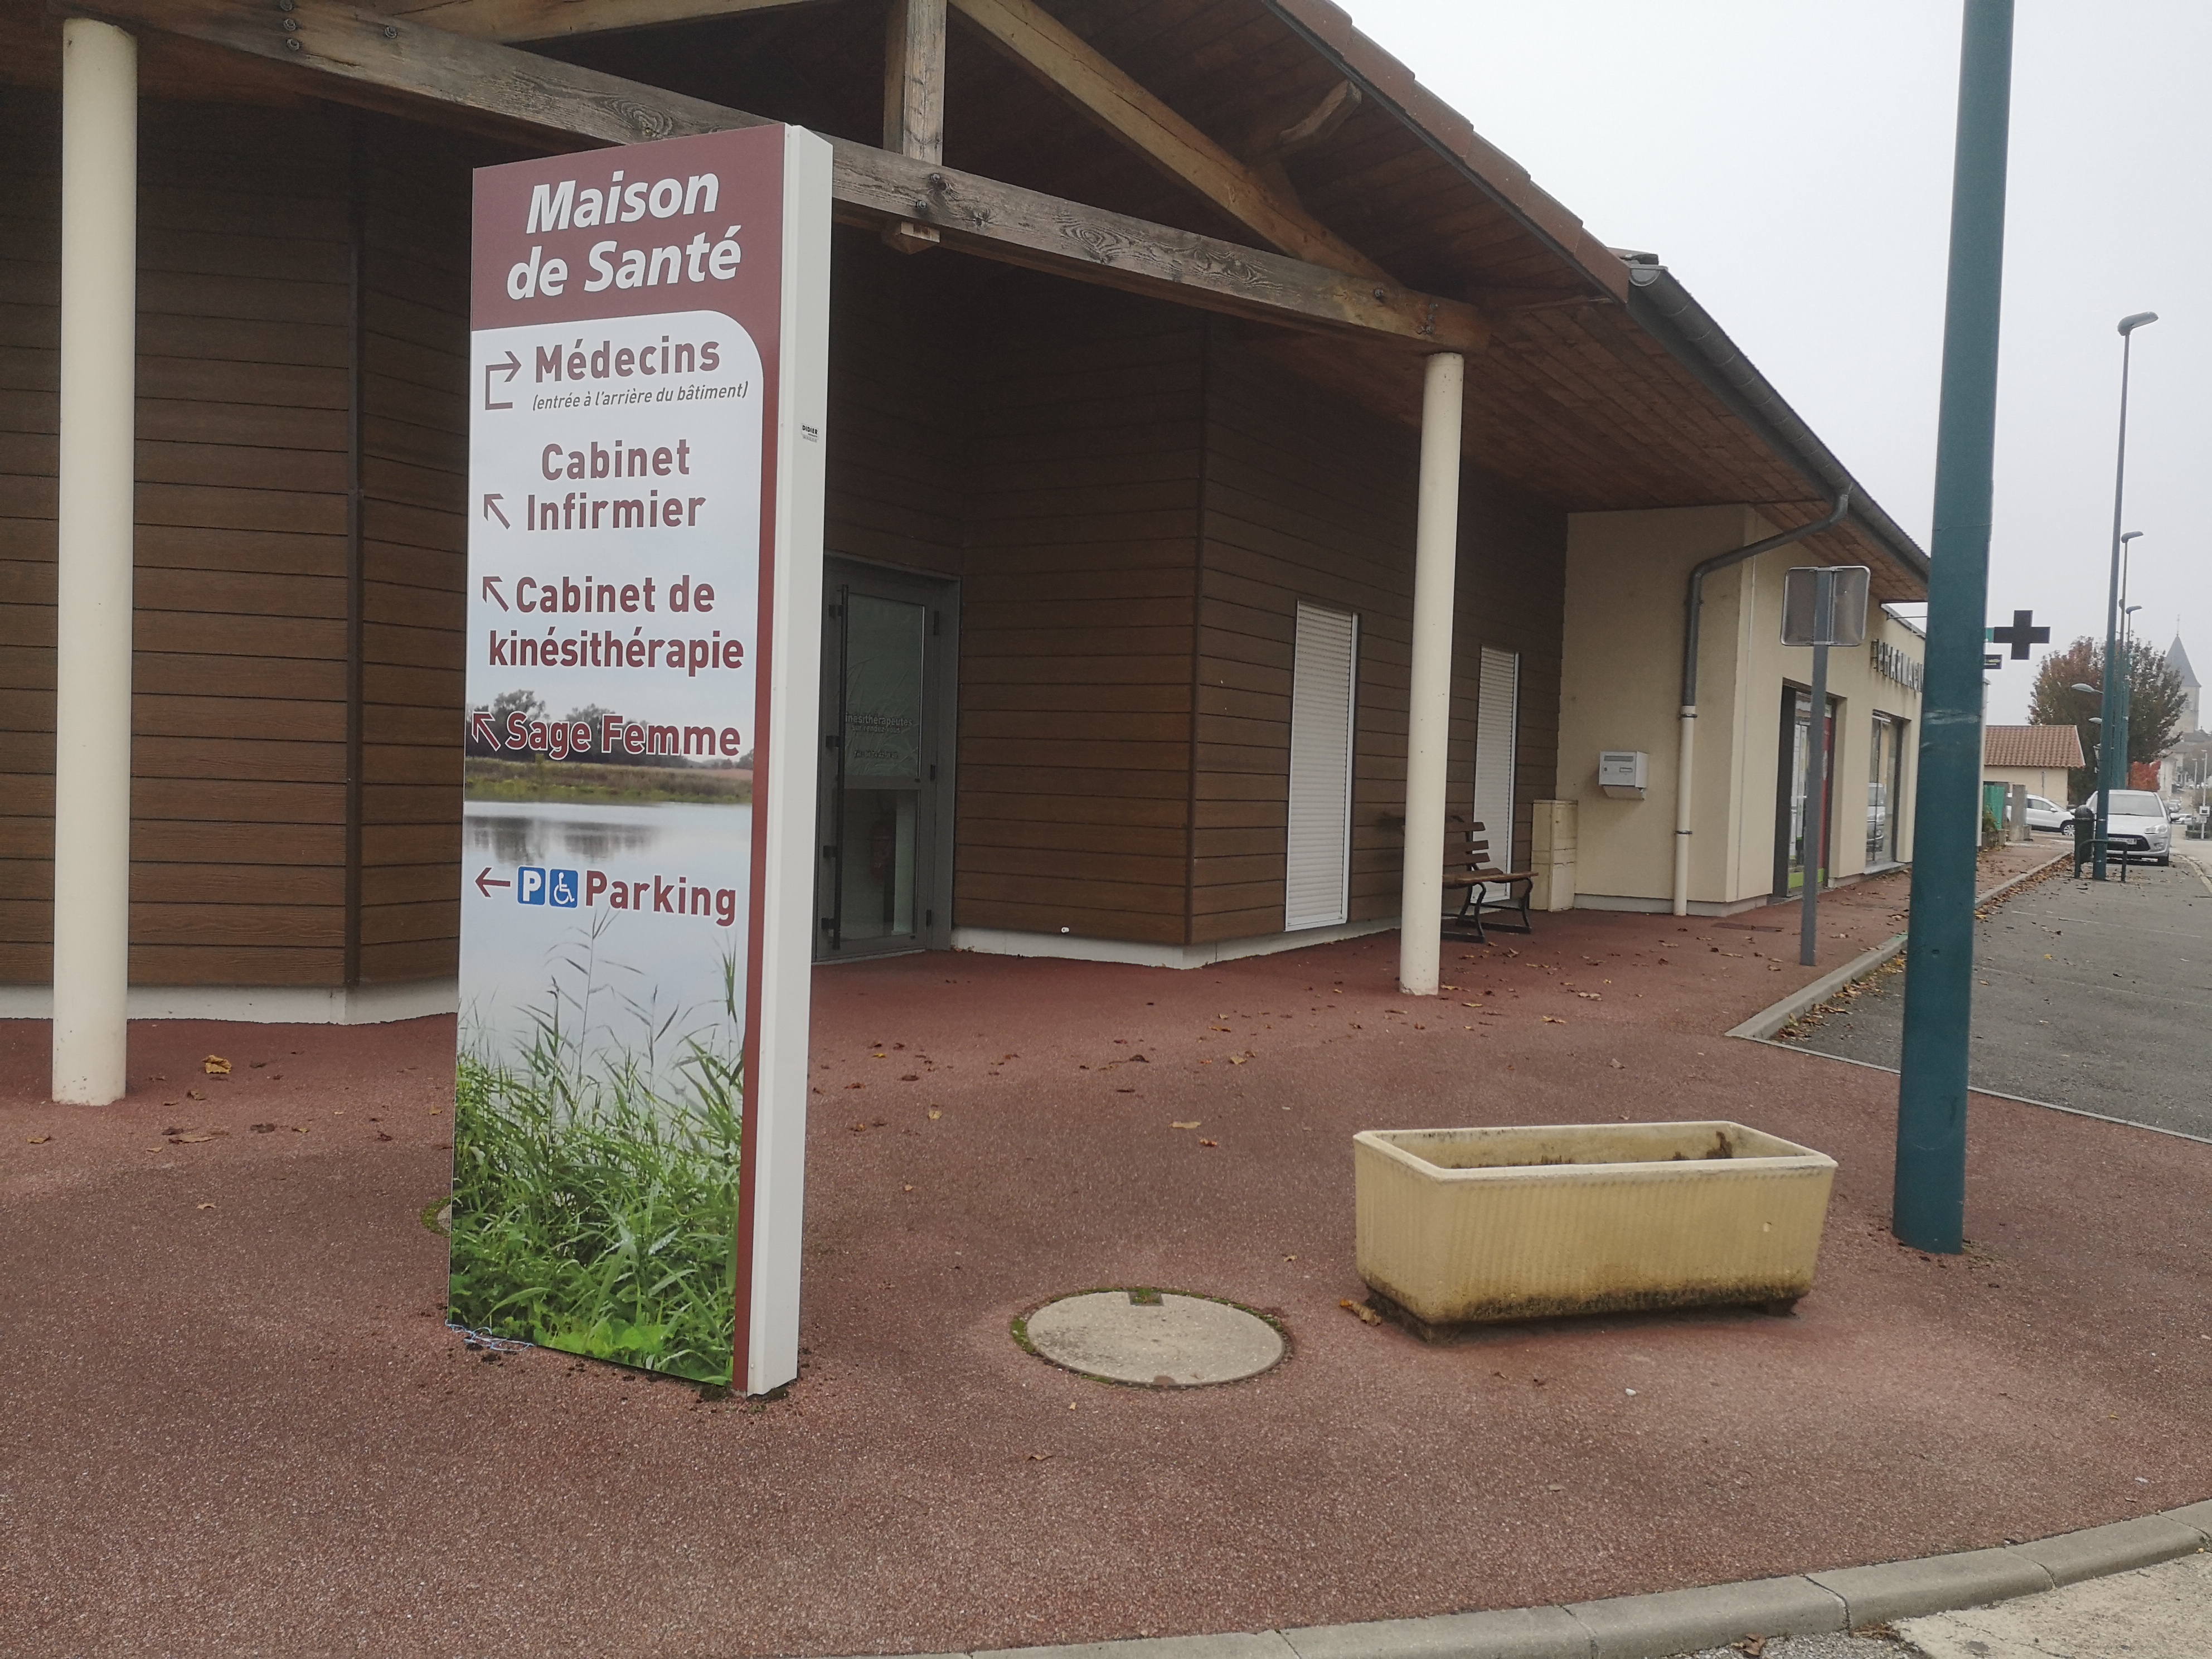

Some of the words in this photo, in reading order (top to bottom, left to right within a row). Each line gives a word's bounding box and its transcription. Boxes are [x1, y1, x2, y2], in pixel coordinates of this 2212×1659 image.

[525, 170, 719, 234] Maison
[506, 245, 567, 300] de
[584, 225, 741, 292] Santé
[535, 335, 720, 383] Médecins
[532, 392, 580, 411] (entrée
[583, 391, 591, 406] à
[595, 389, 652, 406] l'arrière
[656, 387, 674, 402] du
[677, 381, 749, 401] bâtiment)
[802, 425, 818, 435] DIDIER
[541, 439, 690, 481] Cabinet
[527, 489, 706, 531] Infirmier
[516, 575, 656, 613] Cabinet
[669, 574, 715, 612] de
[489, 626, 744, 677] kinésithérapie
[506, 711, 591, 760] Sage
[601, 714, 740, 756] Femme
[845, 712, 913, 726] inésithérapeutes
[523, 870, 542, 902] P
[585, 870, 736, 926] Parking
